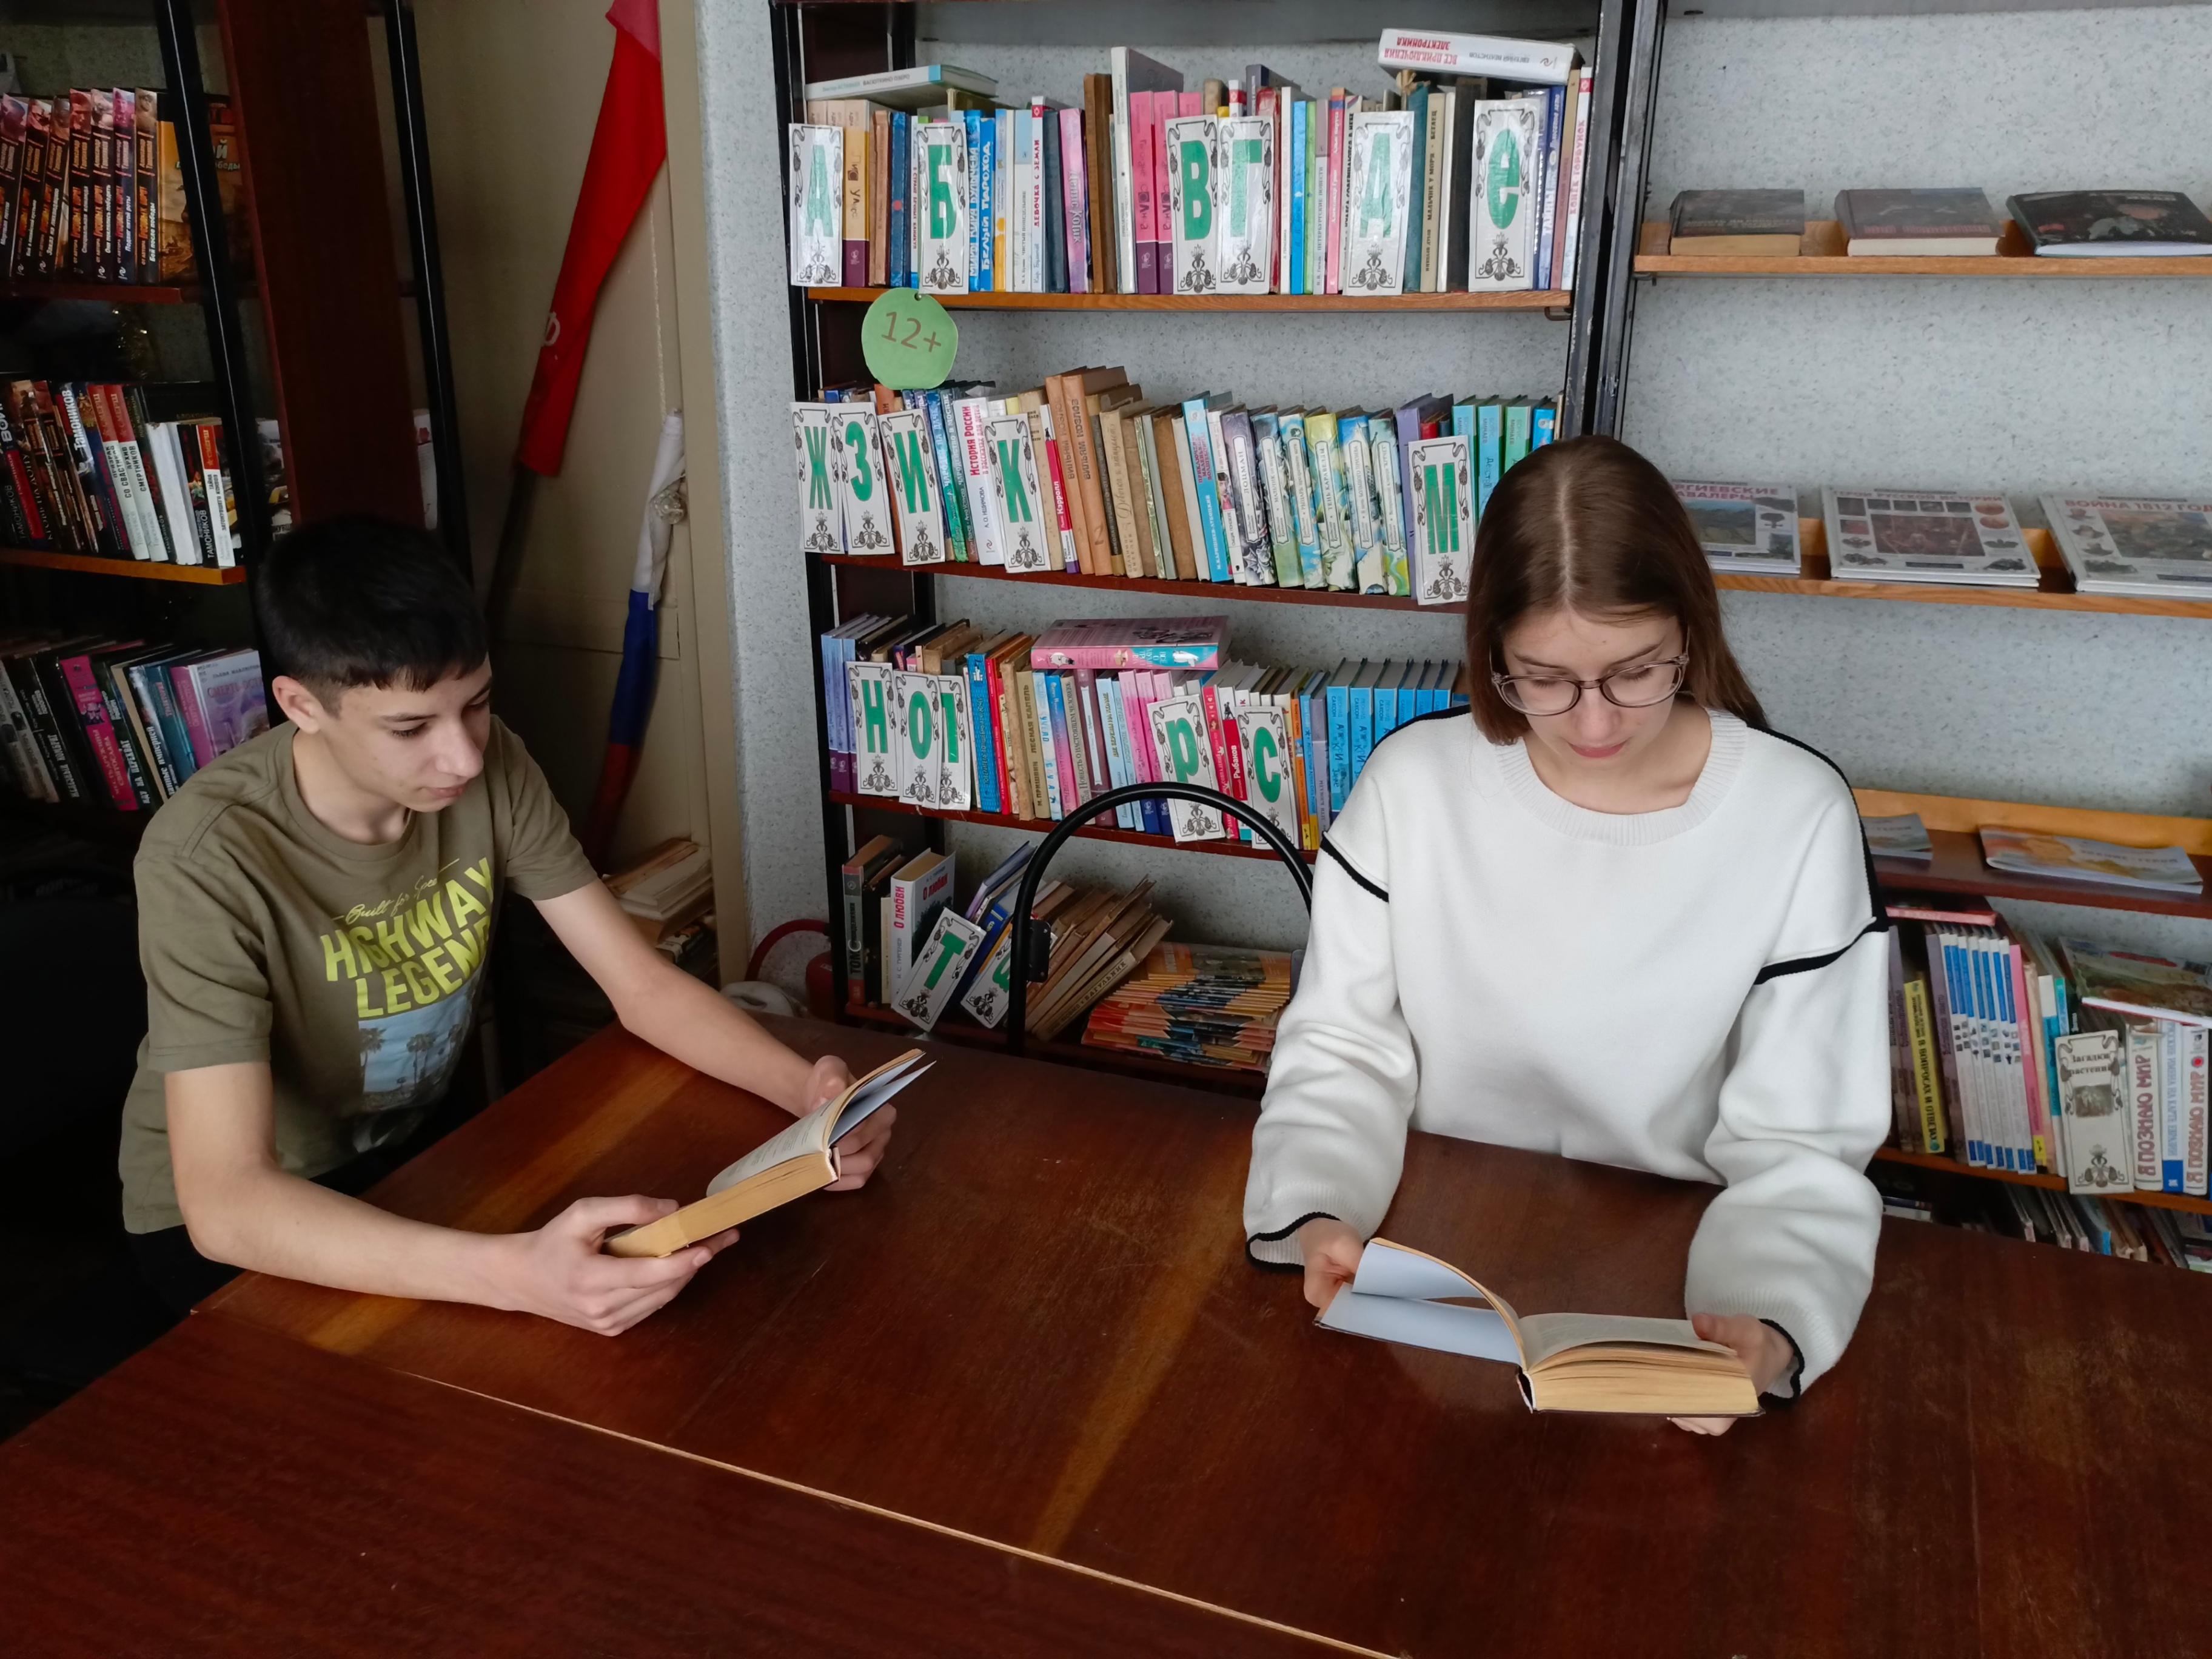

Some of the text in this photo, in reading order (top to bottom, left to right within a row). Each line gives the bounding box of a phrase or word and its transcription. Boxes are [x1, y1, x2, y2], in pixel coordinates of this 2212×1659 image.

[1384, 48, 1457, 65] ВСЕ ПРИКЛЮЧЕНИЯ
[1396, 36, 1450, 50] ЭЛЕКТРОНИКА
[805, 145, 834, 237] А
[928, 144, 956, 240] Б
[1181, 139, 1212, 241] В
[1230, 138, 1262, 238] Г
[969, 147, 979, 276] МИРЫ КИРА БУЛЫЧЕВА
[880, 310, 942, 353] 12+
[111, 393, 124, 427] СМЕРШ
[943, 394, 953, 426] МОСКВЕ
[203, 429, 213, 458] СМЕРШ
[978, 438, 988, 470] рассказах
[1063, 440, 1075, 480] ВИЛЬЯМ
[1071, 398, 1091, 480] ВИЛЬЯМ КОЗЛОВ
[122, 446, 133, 469] АРХИВ
[129, 445, 147, 492] СМЕРТНИКОВ
[804, 426, 833, 510] Ж
[845, 421, 873, 501] З
[894, 430, 931, 514] И
[997, 440, 1033, 523] К
[1238, 451, 1250, 494] ЛОЦМАН
[1319, 447, 1330, 491] КАРАВЕЛЛЫ
[125, 488, 132, 498] СО
[979, 486, 988, 515] ИШИМОВА
[1054, 481, 1064, 514] Кэрролл
[1270, 475, 1279, 503] МАЛЬЧИК
[1423, 463, 1460, 555] М
[2064, 499, 2170, 511] ВОЙНА 1812
[199, 509, 215, 559] ТАМОНИКОВ
[861, 679, 889, 754] Н
[1023, 685, 1033, 719] КАПЕЛЬ
[1065, 682, 1075, 712] ЧЕЛОВЕКЕ
[908, 691, 933, 759] О
[1028, 721, 1037, 754] ЛЕСНАЯ
[1070, 713, 1081, 752] НАСТОЯЩЕМ
[119, 739, 140, 773] ПЕРЕХВАТ
[1230, 745, 1242, 779] Рыбаков
[135, 776, 145, 786] НА
[346, 893, 410, 925] Built for
[922, 886, 928, 900] О
[320, 857, 494, 982] HIGHWAY
[923, 930, 967, 991] Т
[1084, 960, 1127, 1002] БАГУЛЬНИК
[1920, 1048, 1937, 1141] ВОПРОСАХ ОТВЕТАХ
[2132, 1054, 2156, 1176] Я ПОЗНАЮ МИР
[2167, 1100, 2177, 1123] КАРТЕ
[2187, 1071, 2204, 1184] Я ПОЗНАЮ МИР
